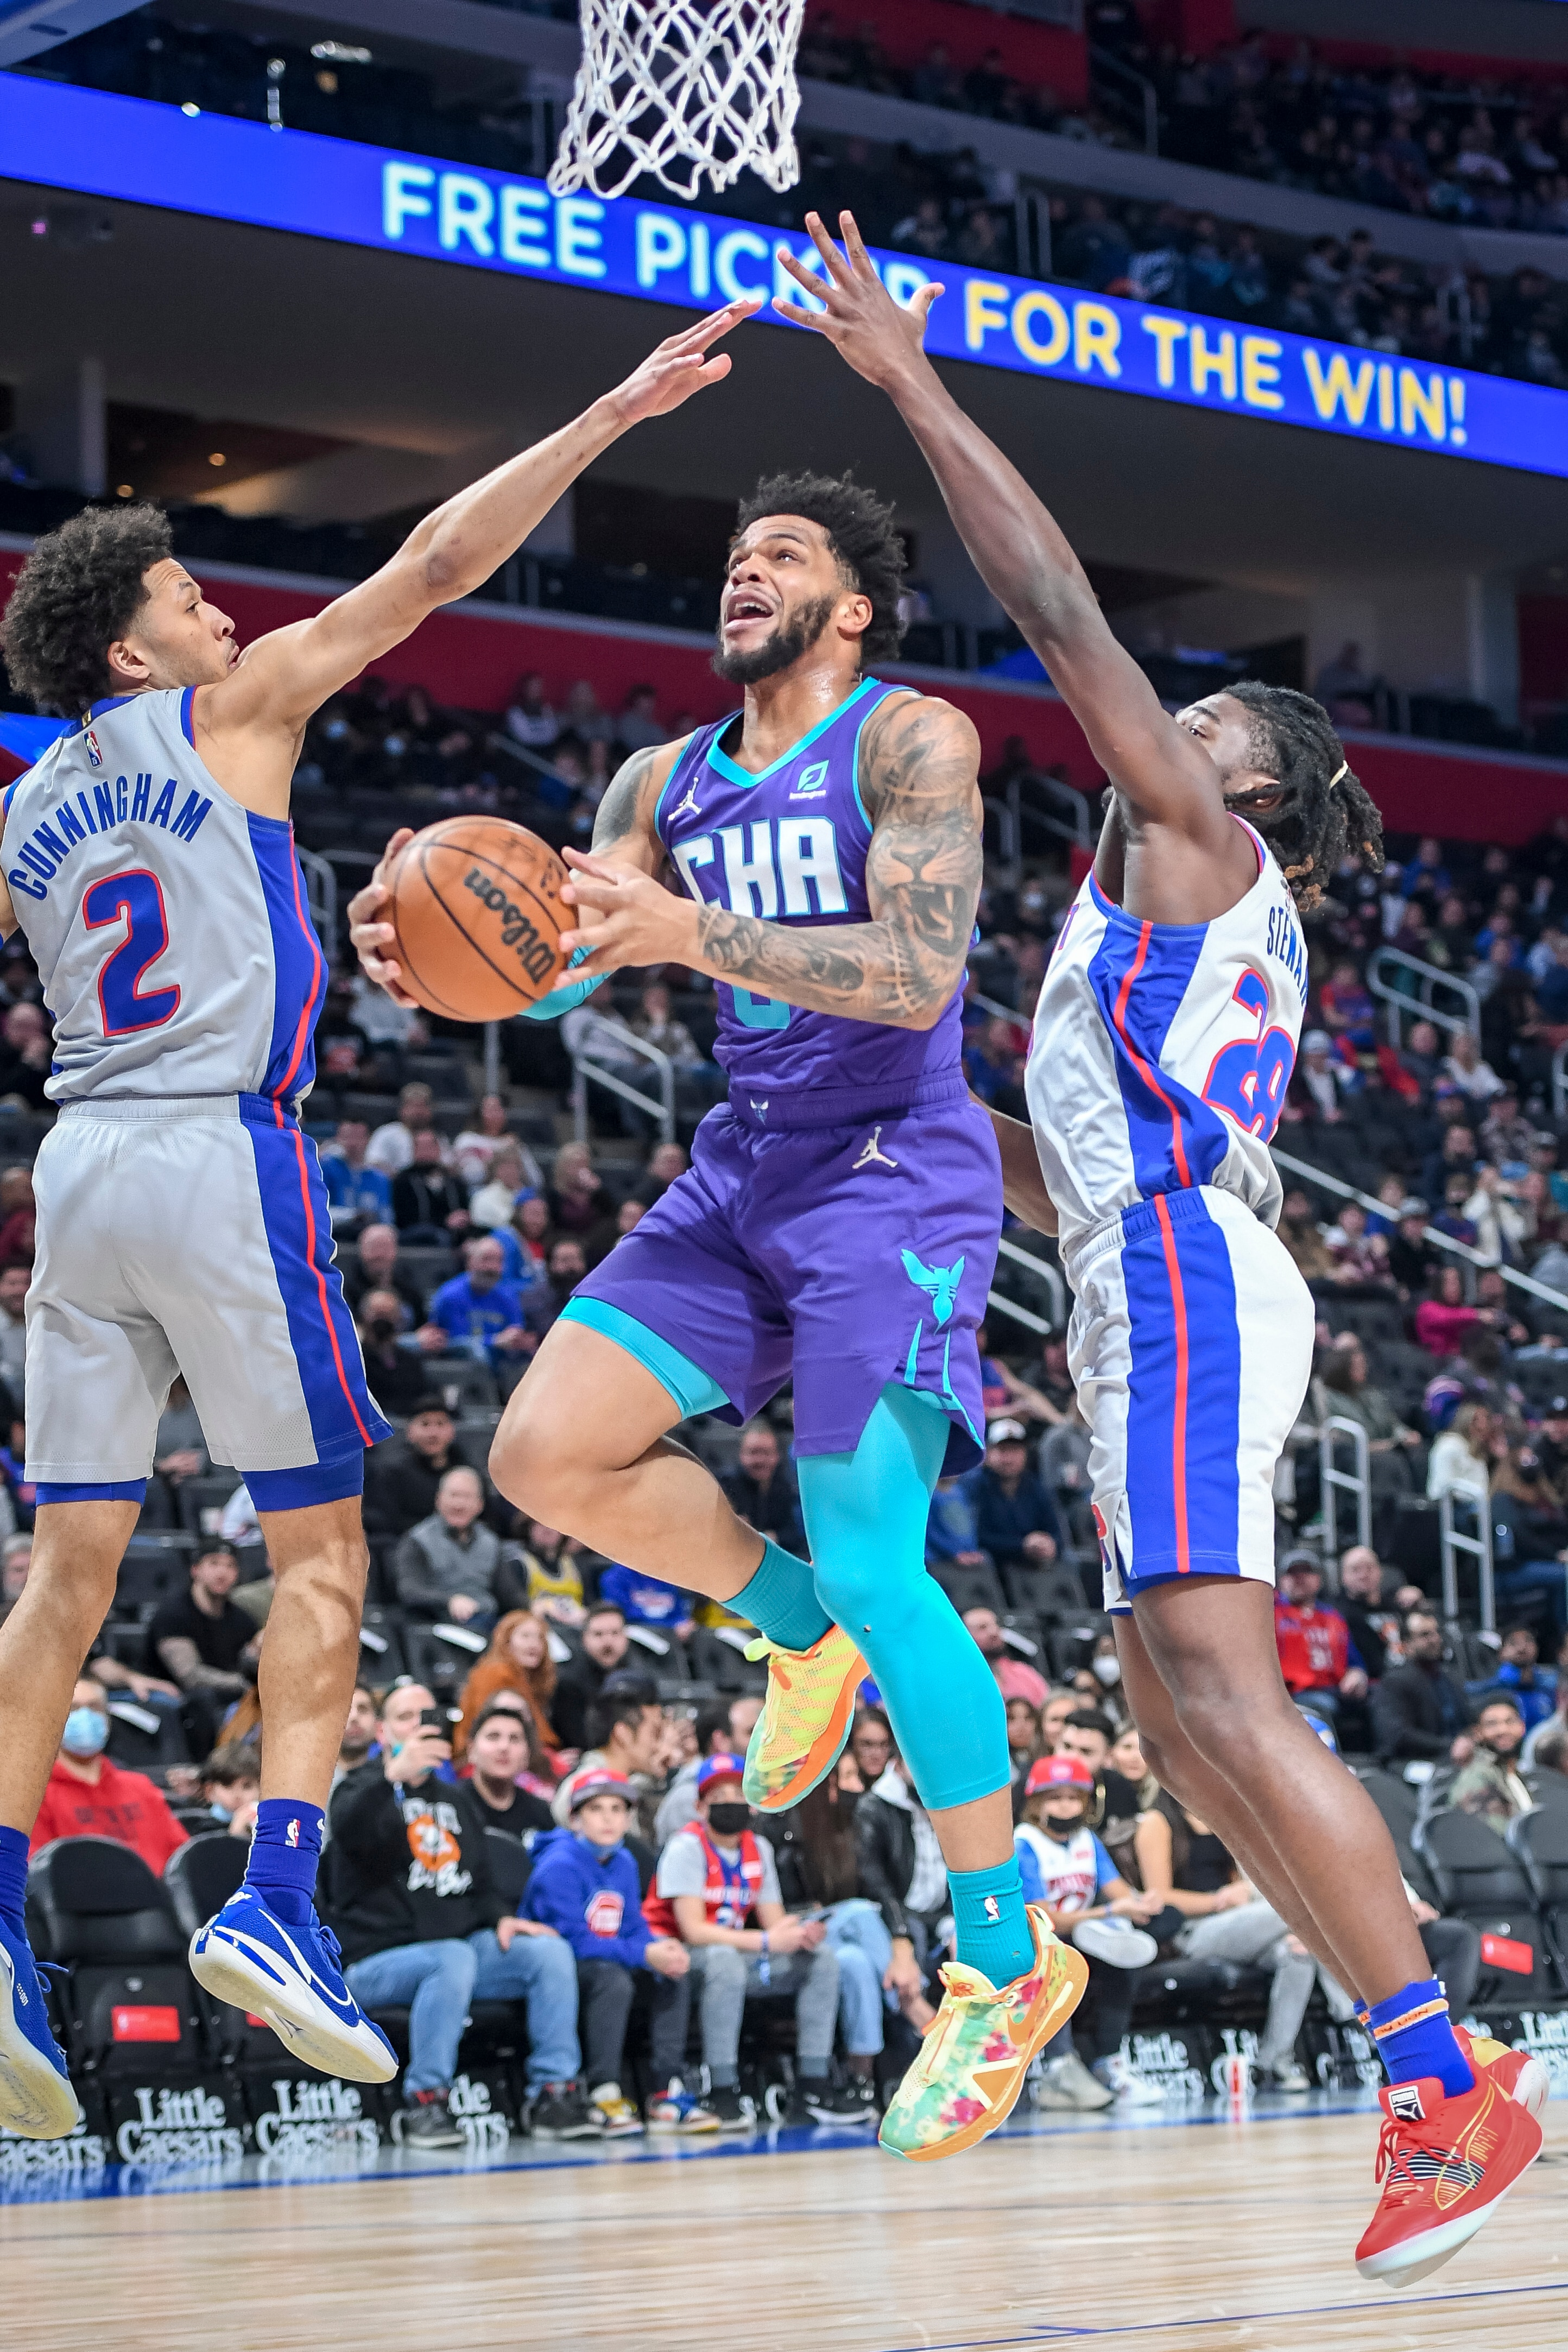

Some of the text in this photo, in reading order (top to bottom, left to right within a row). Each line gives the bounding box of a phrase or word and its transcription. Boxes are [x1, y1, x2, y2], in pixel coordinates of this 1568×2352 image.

[383, 161, 1468, 446] FREE PICKP FOR THE WIN!
[8, 773, 213, 901] CUNNINGHAM
[671, 815, 849, 919] CHA
[83, 869, 180, 1038] 2
[463, 867, 556, 985] Wilson
[1201, 967, 1297, 1146] 28
[0, 2134, 106, 2170] aesars
[116, 2120, 244, 2164] Caesars
[134, 2086, 226, 2129] Little
[272, 2078, 363, 2120] Little
